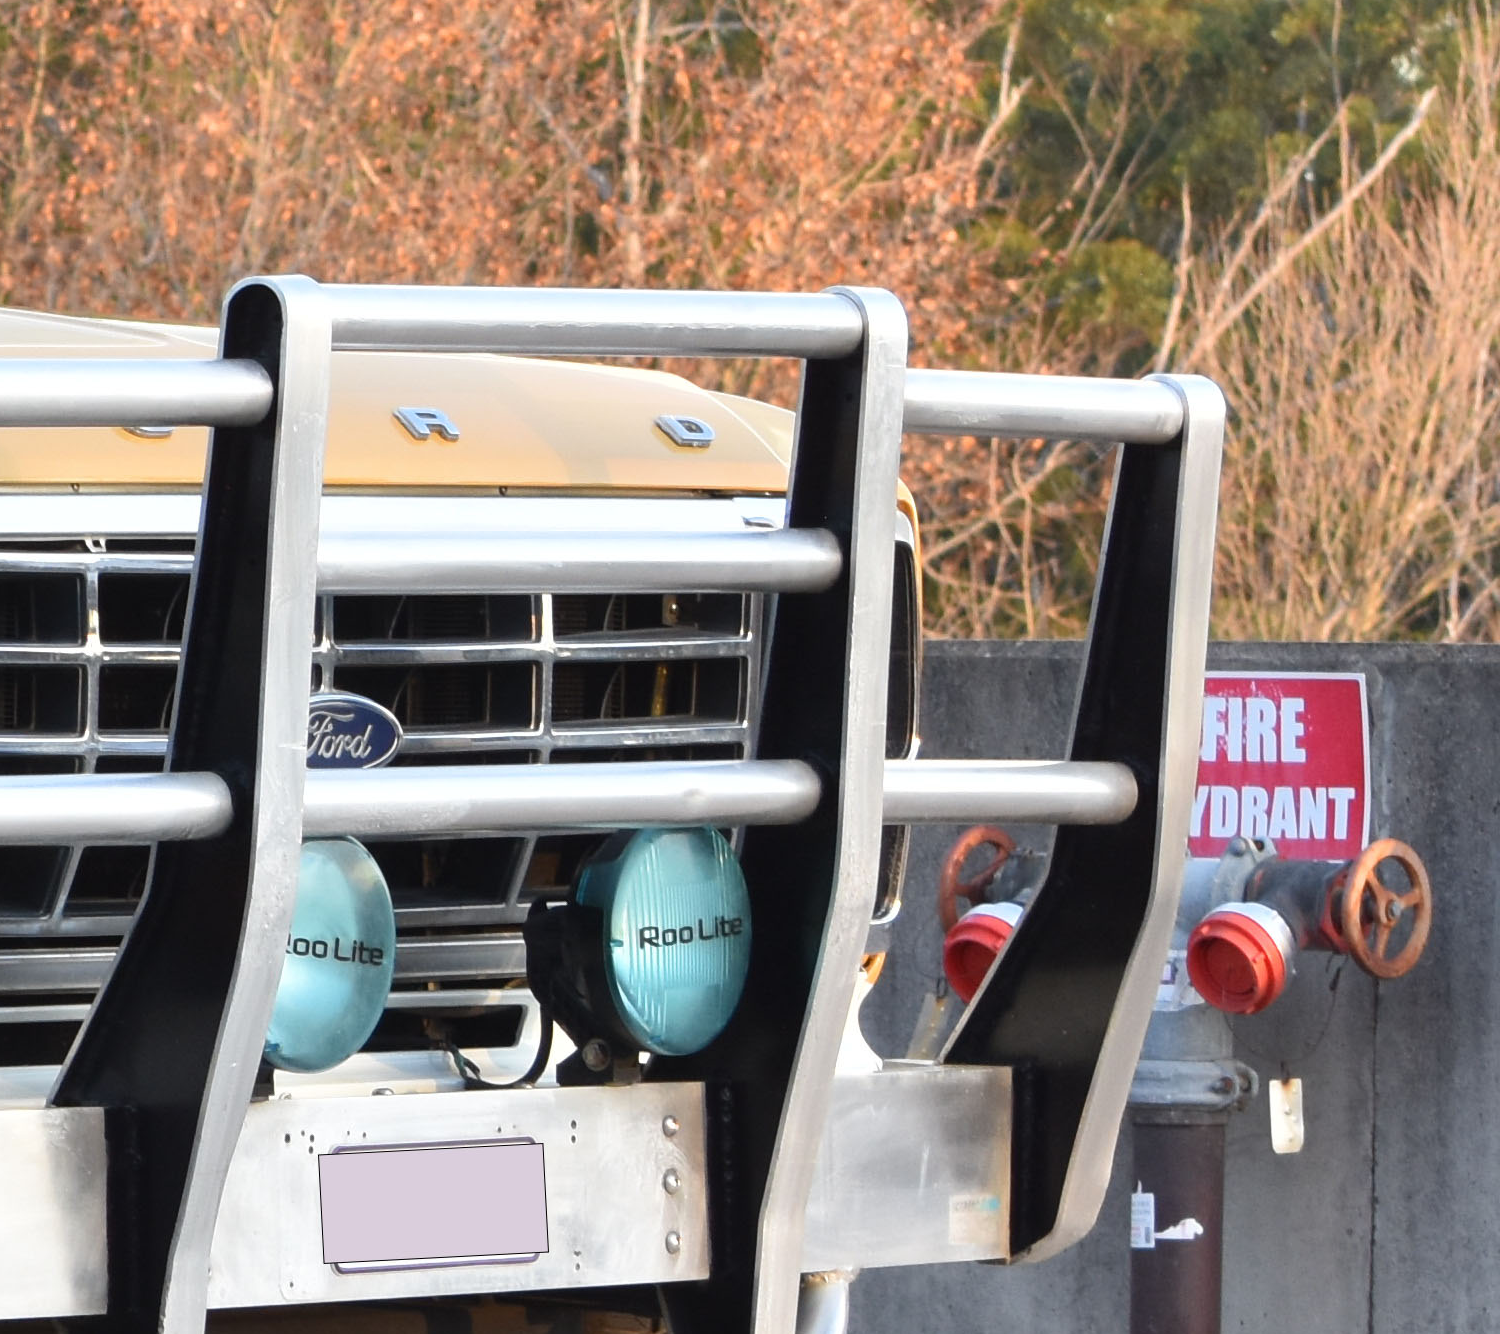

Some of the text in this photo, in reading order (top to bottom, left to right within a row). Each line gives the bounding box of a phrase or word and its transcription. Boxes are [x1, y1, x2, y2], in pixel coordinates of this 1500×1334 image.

[307, 710, 373, 759] Ford
[1200, 696, 1307, 763] FIRE
[1189, 784, 1356, 840] YDRANT
[285, 933, 384, 966] oo Lite
[639, 916, 742, 949] Roo Lite
